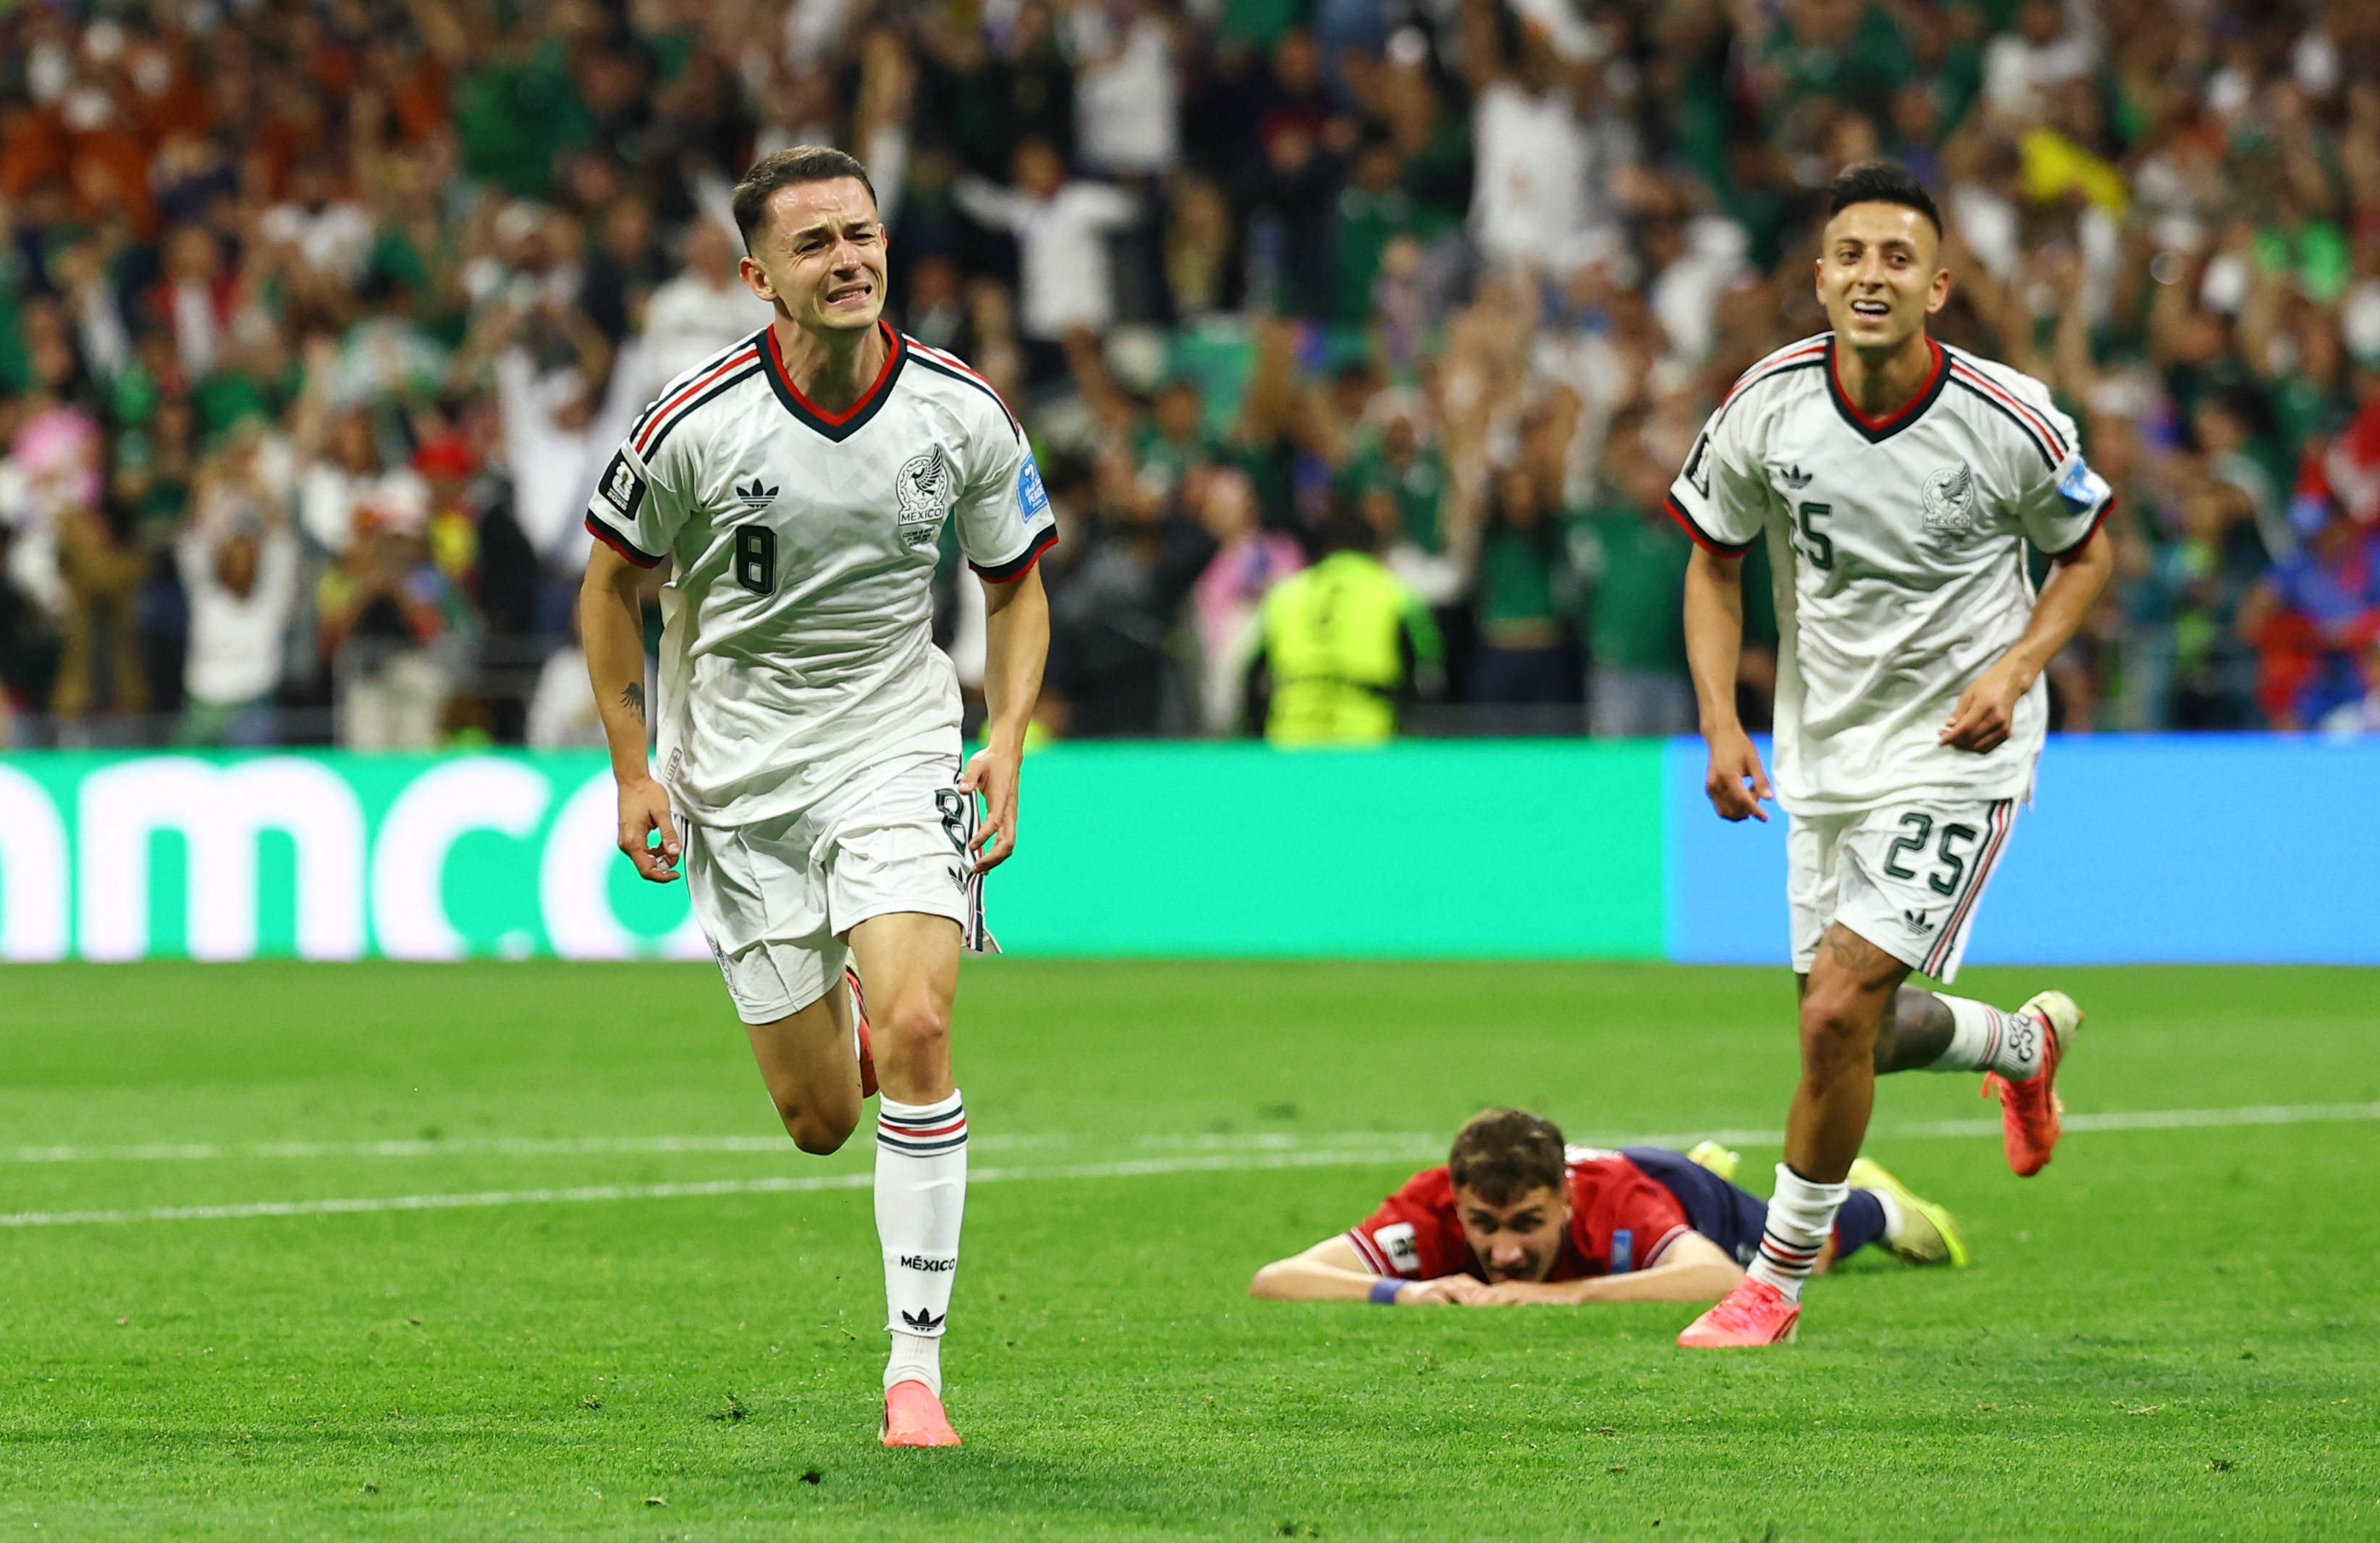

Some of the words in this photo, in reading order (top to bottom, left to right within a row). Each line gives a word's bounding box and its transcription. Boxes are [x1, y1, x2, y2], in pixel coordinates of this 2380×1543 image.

[735, 525, 777, 597] 8
[934, 788, 966, 858] 8
[1883, 811, 1977, 897] 25
[900, 1255, 955, 1272] MÉXICO
